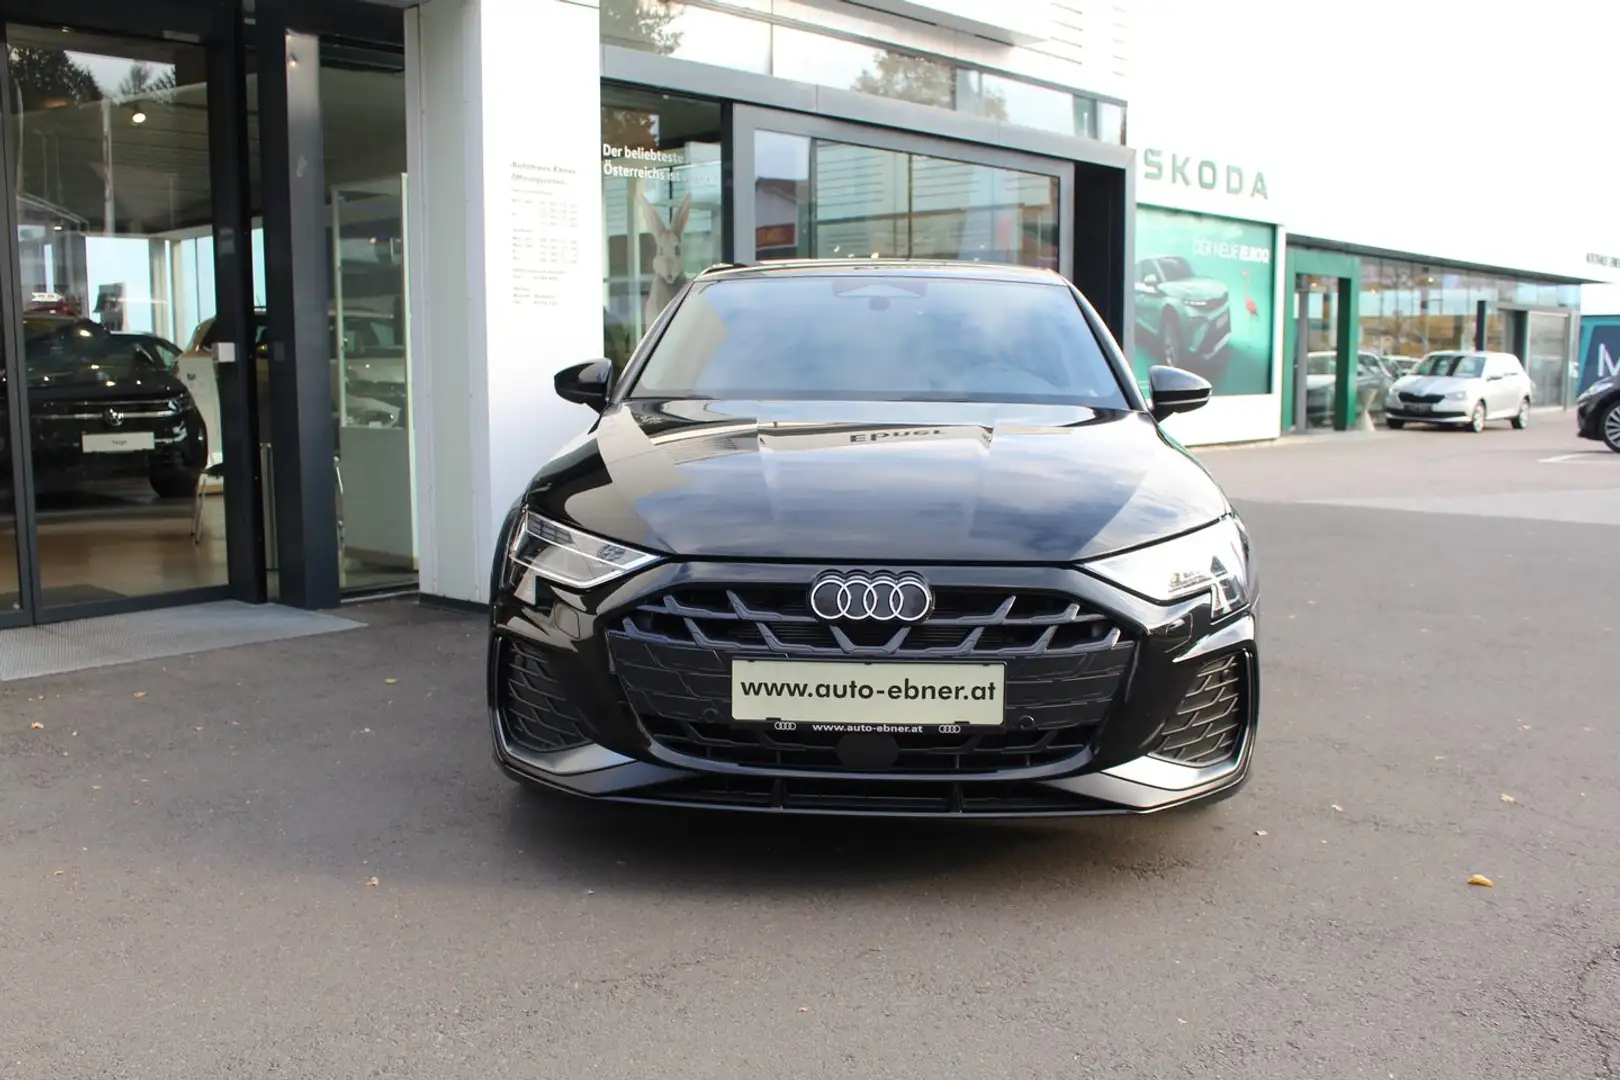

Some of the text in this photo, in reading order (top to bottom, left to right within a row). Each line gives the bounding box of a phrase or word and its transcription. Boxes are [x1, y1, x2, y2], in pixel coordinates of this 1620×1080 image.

[602, 143, 684, 163] Der beliebteste
[603, 159, 664, 180] Österreichs
[740, 678, 996, 700] www.auto-ebner.at
[811, 723, 924, 734] www.auto-ebner.at
